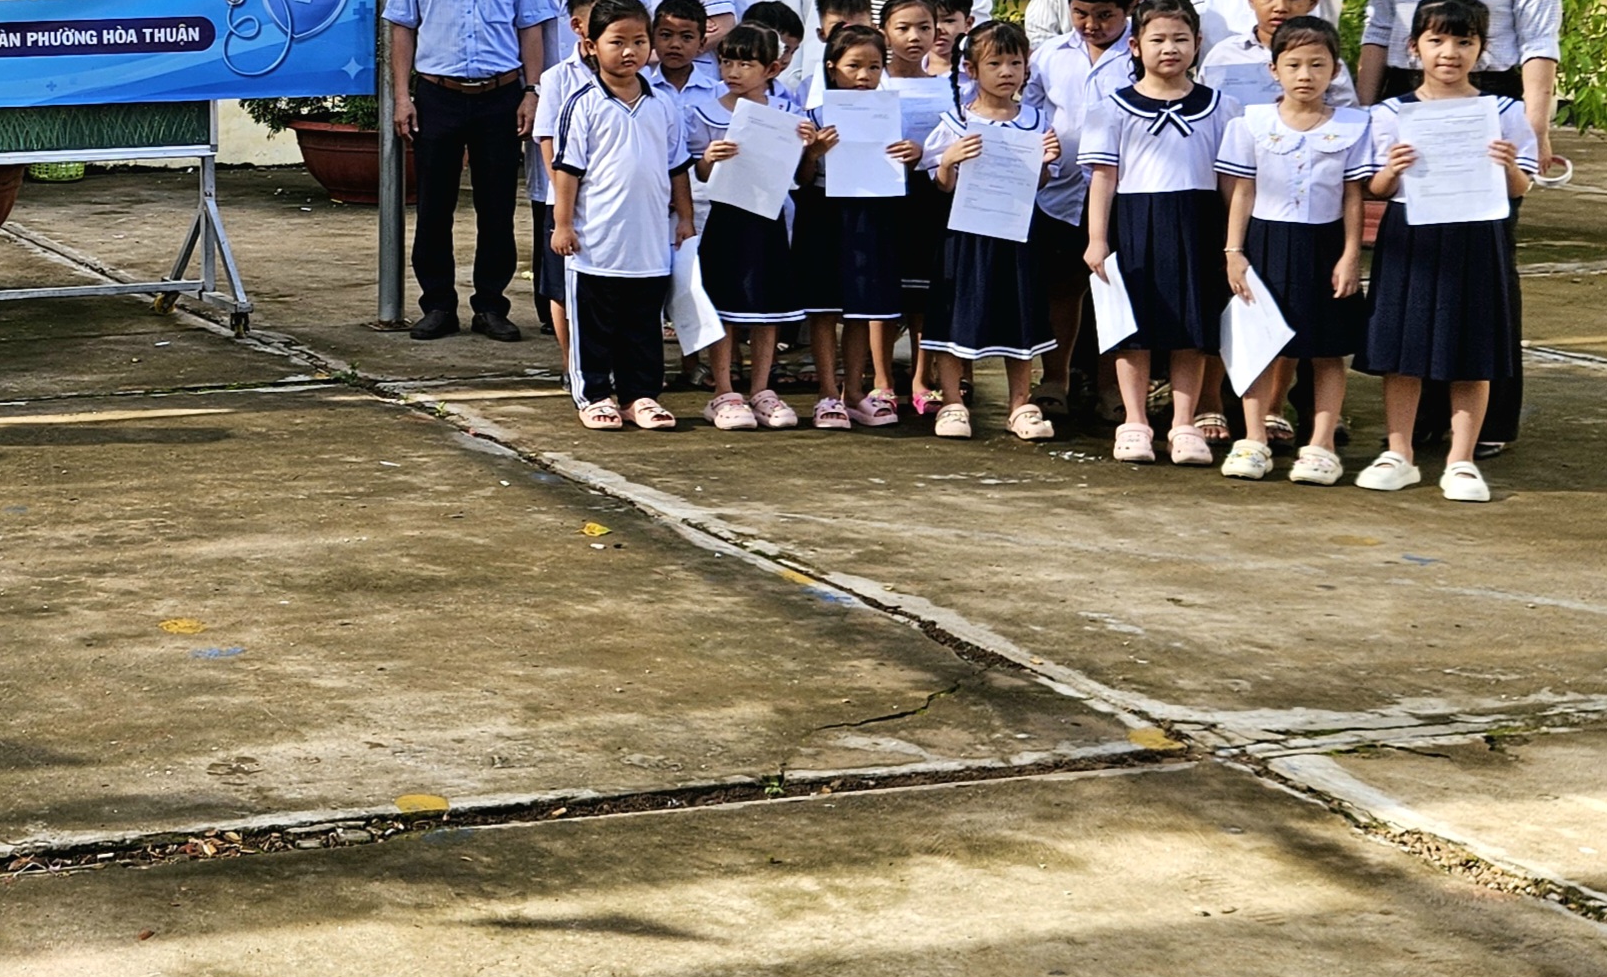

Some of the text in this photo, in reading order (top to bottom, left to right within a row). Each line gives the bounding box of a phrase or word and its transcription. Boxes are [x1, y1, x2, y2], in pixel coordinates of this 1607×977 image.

[26, 26, 98, 47] PHƯỜNG
[103, 26, 138, 45] HÒA
[142, 24, 200, 46] THUẬN
